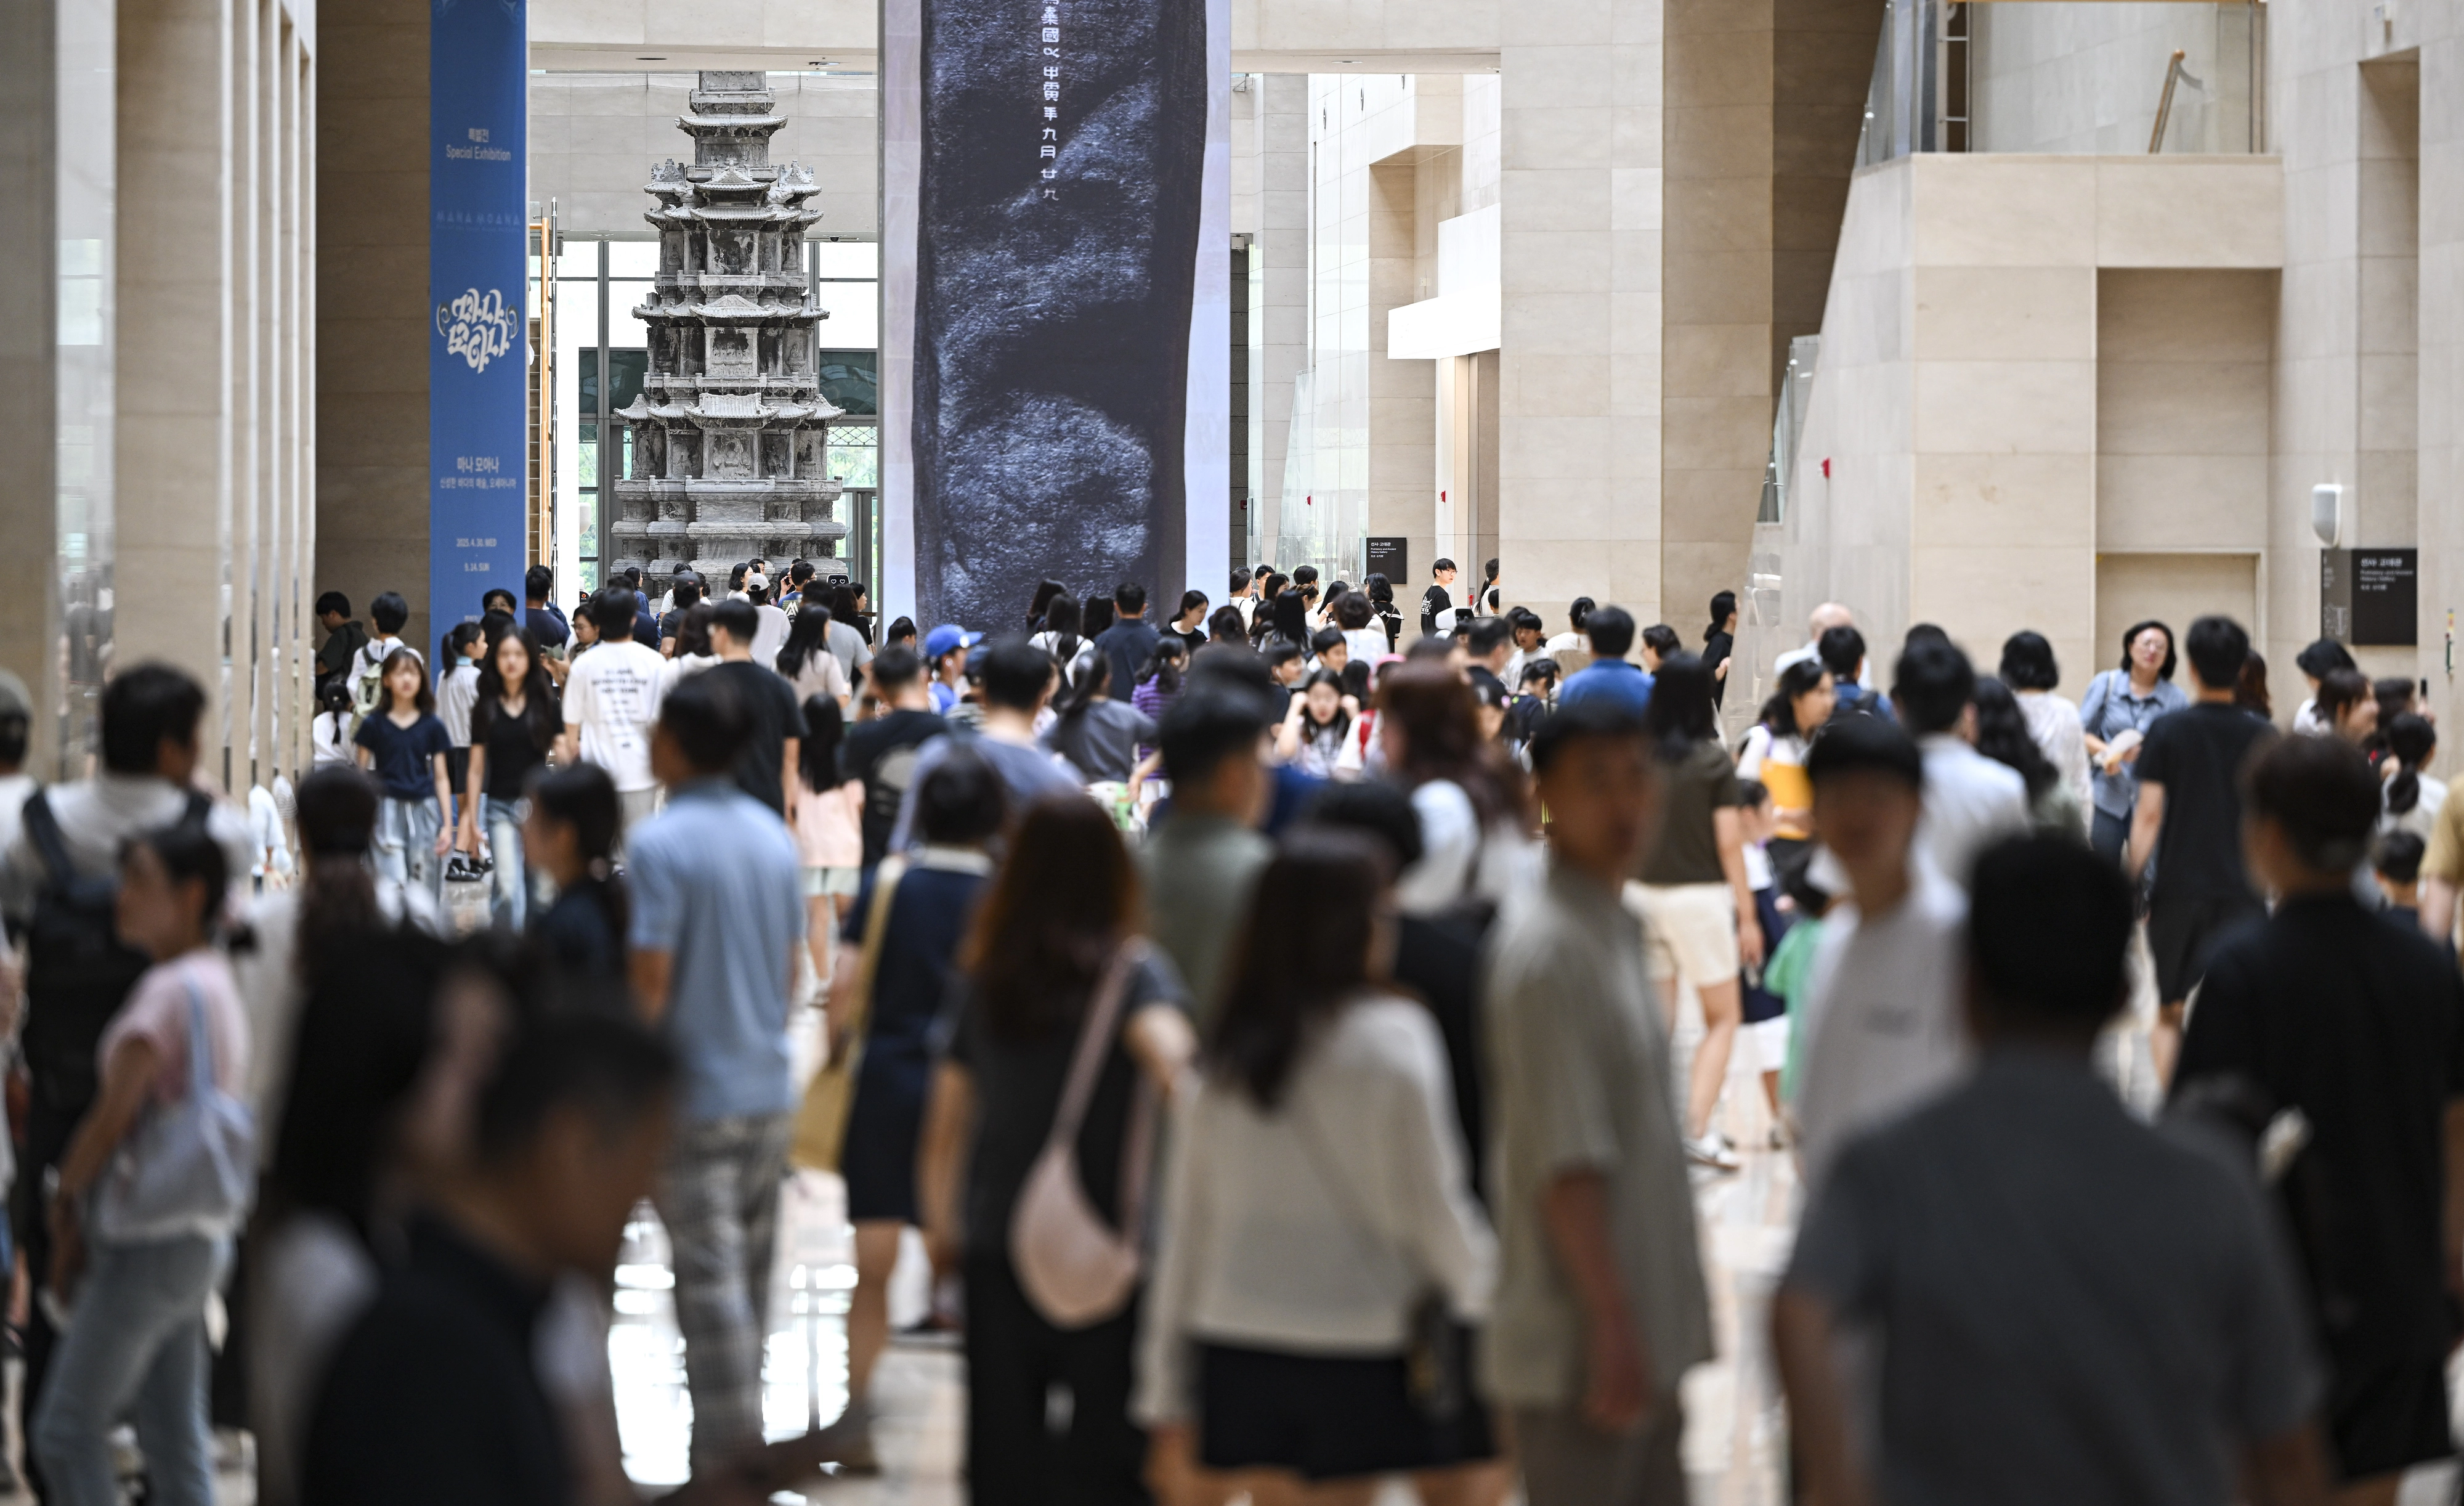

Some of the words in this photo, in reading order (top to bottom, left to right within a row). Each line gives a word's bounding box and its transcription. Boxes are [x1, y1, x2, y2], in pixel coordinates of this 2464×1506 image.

[446, 144, 473, 159] Special
[474, 146, 511, 161] Exhibition
[457, 457, 473, 473] 마나
[475, 457, 500, 473] 모아나
[458, 478, 474, 489] 바다의
[490, 478, 516, 489] 오세아니아
